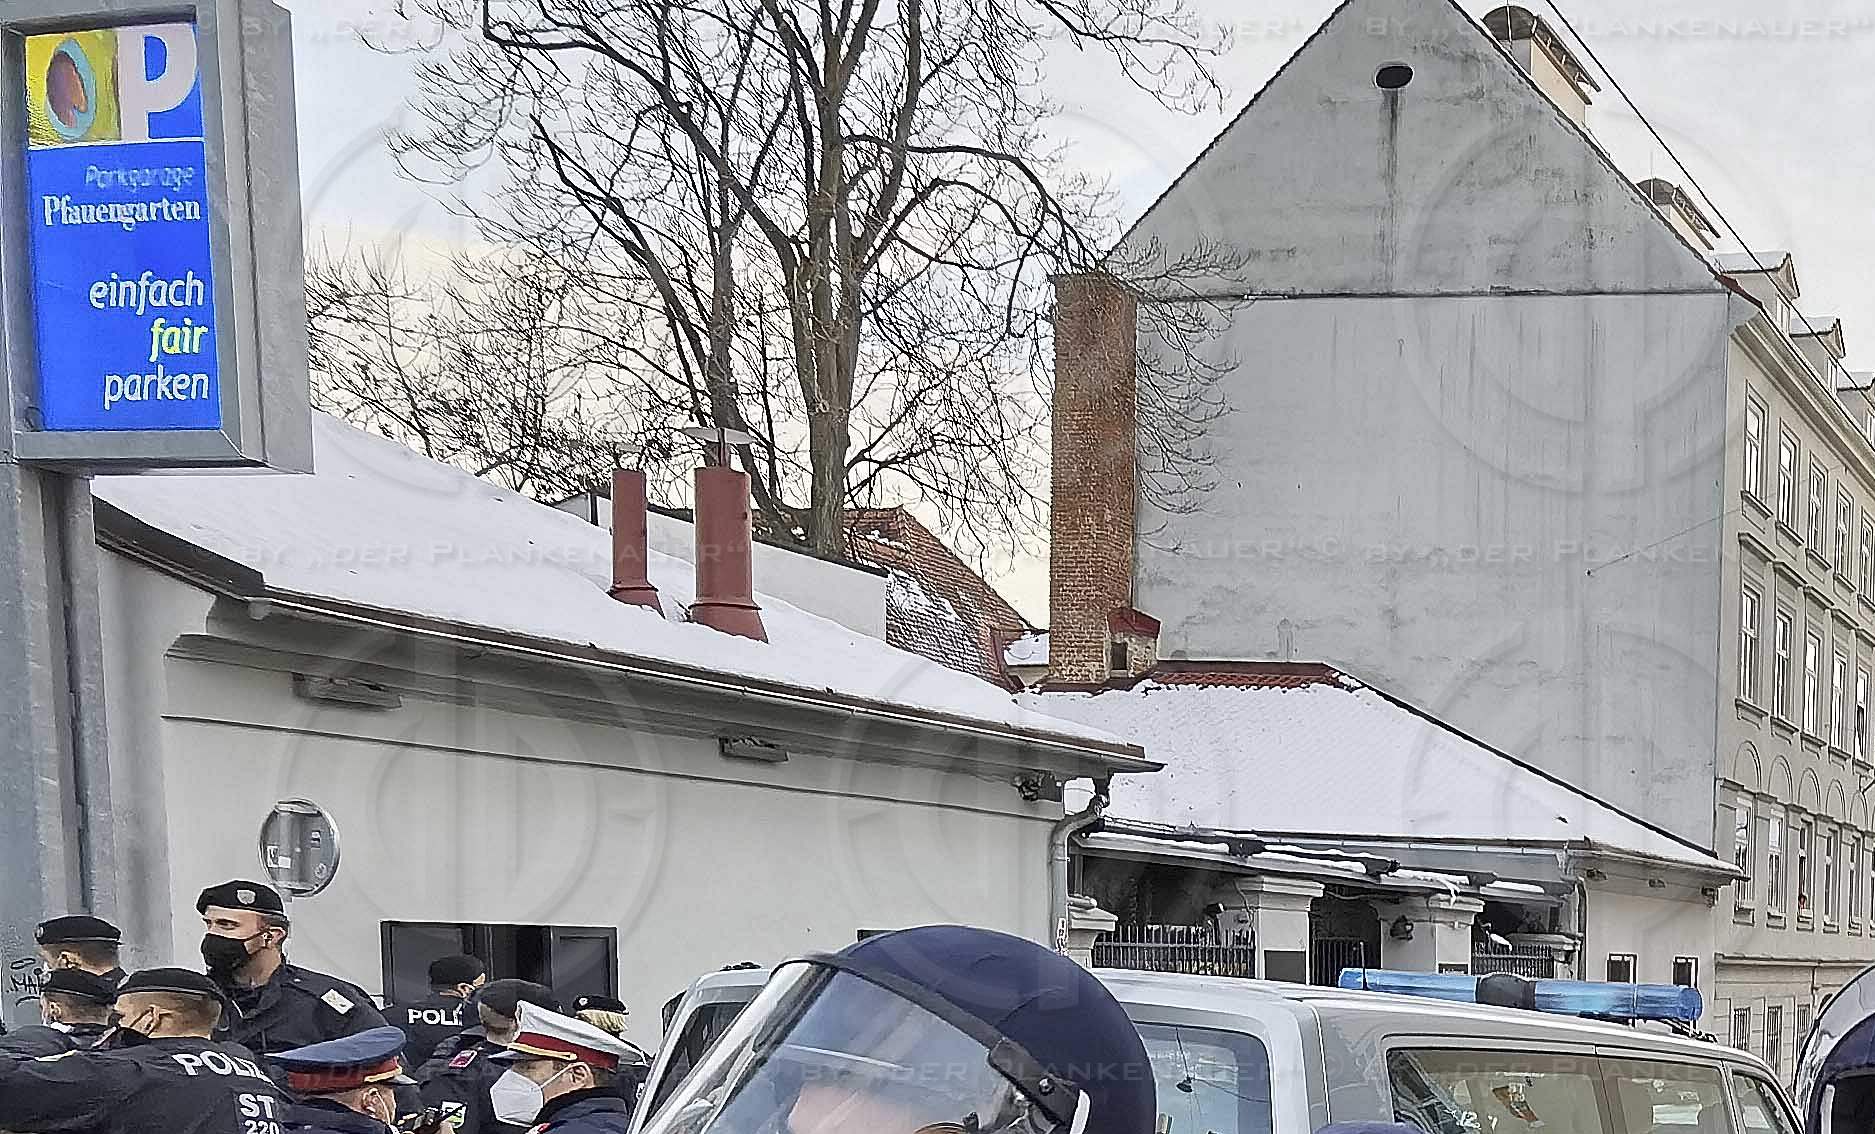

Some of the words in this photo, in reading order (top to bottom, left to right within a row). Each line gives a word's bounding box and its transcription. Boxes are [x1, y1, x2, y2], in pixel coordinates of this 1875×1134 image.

[117, 24, 198, 141] P
[42, 195, 201, 231] Pfauengarten
[89, 270, 204, 316] einfach
[149, 318, 209, 362] fair
[104, 364, 209, 410] parken
[408, 1003, 463, 1026] POLI
[239, 1093, 275, 1119] ST
